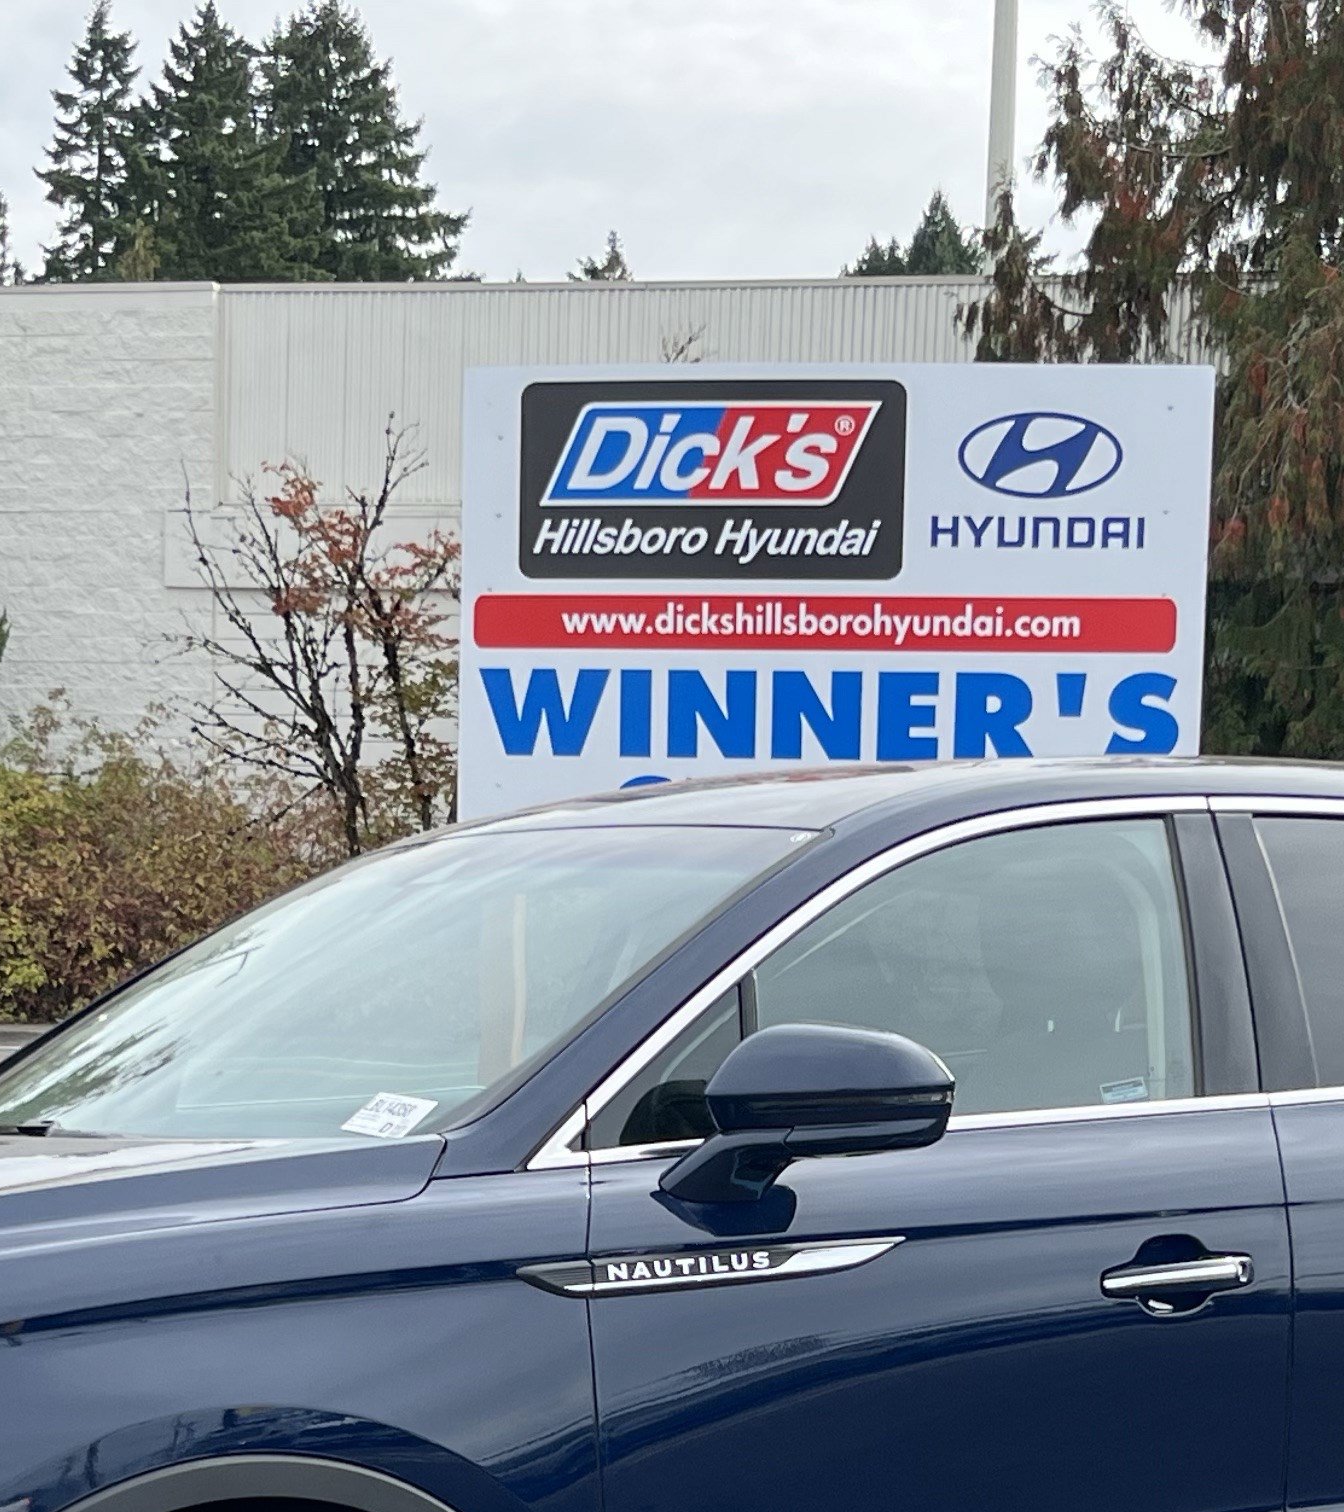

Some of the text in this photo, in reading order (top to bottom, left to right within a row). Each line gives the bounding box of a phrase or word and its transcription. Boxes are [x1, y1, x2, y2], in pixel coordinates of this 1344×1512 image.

[567, 413, 837, 491] Dick's
[532, 518, 882, 564] Hillsboro Hyundai
[930, 516, 1145, 549] HYUNDAI
[561, 601, 1081, 646] www.dickshillsborohyundai.com
[479, 667, 1181, 760] WINNER'S
[607, 1251, 771, 1281] NAUTILUS
